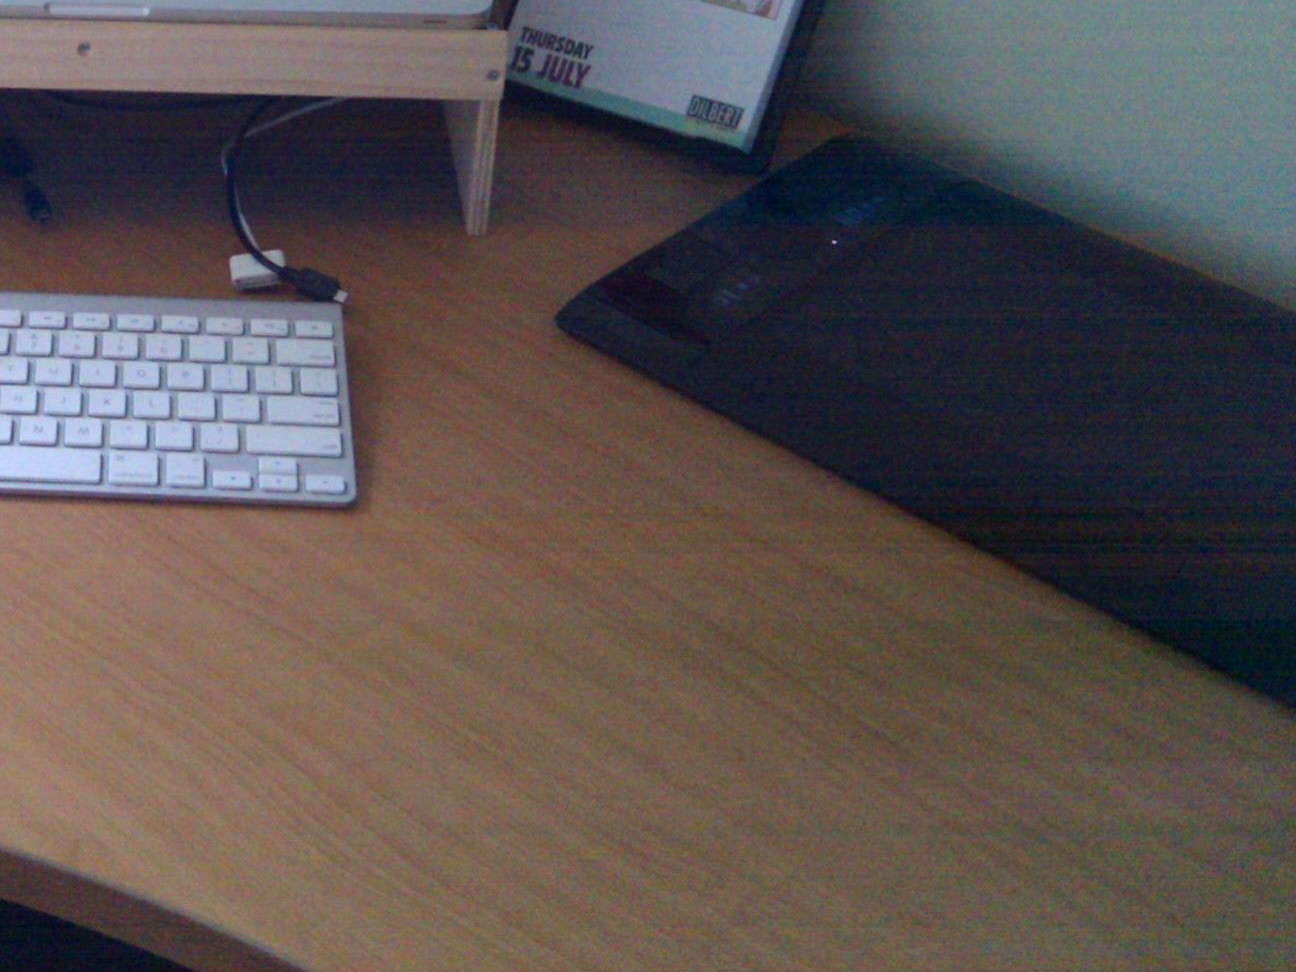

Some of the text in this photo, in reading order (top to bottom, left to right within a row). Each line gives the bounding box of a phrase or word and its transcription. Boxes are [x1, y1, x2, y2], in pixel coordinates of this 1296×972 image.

[520, 26, 594, 59] THURSDAY
[509, 47, 591, 90] 15 JULY
[688, 95, 742, 127] DILBERT
